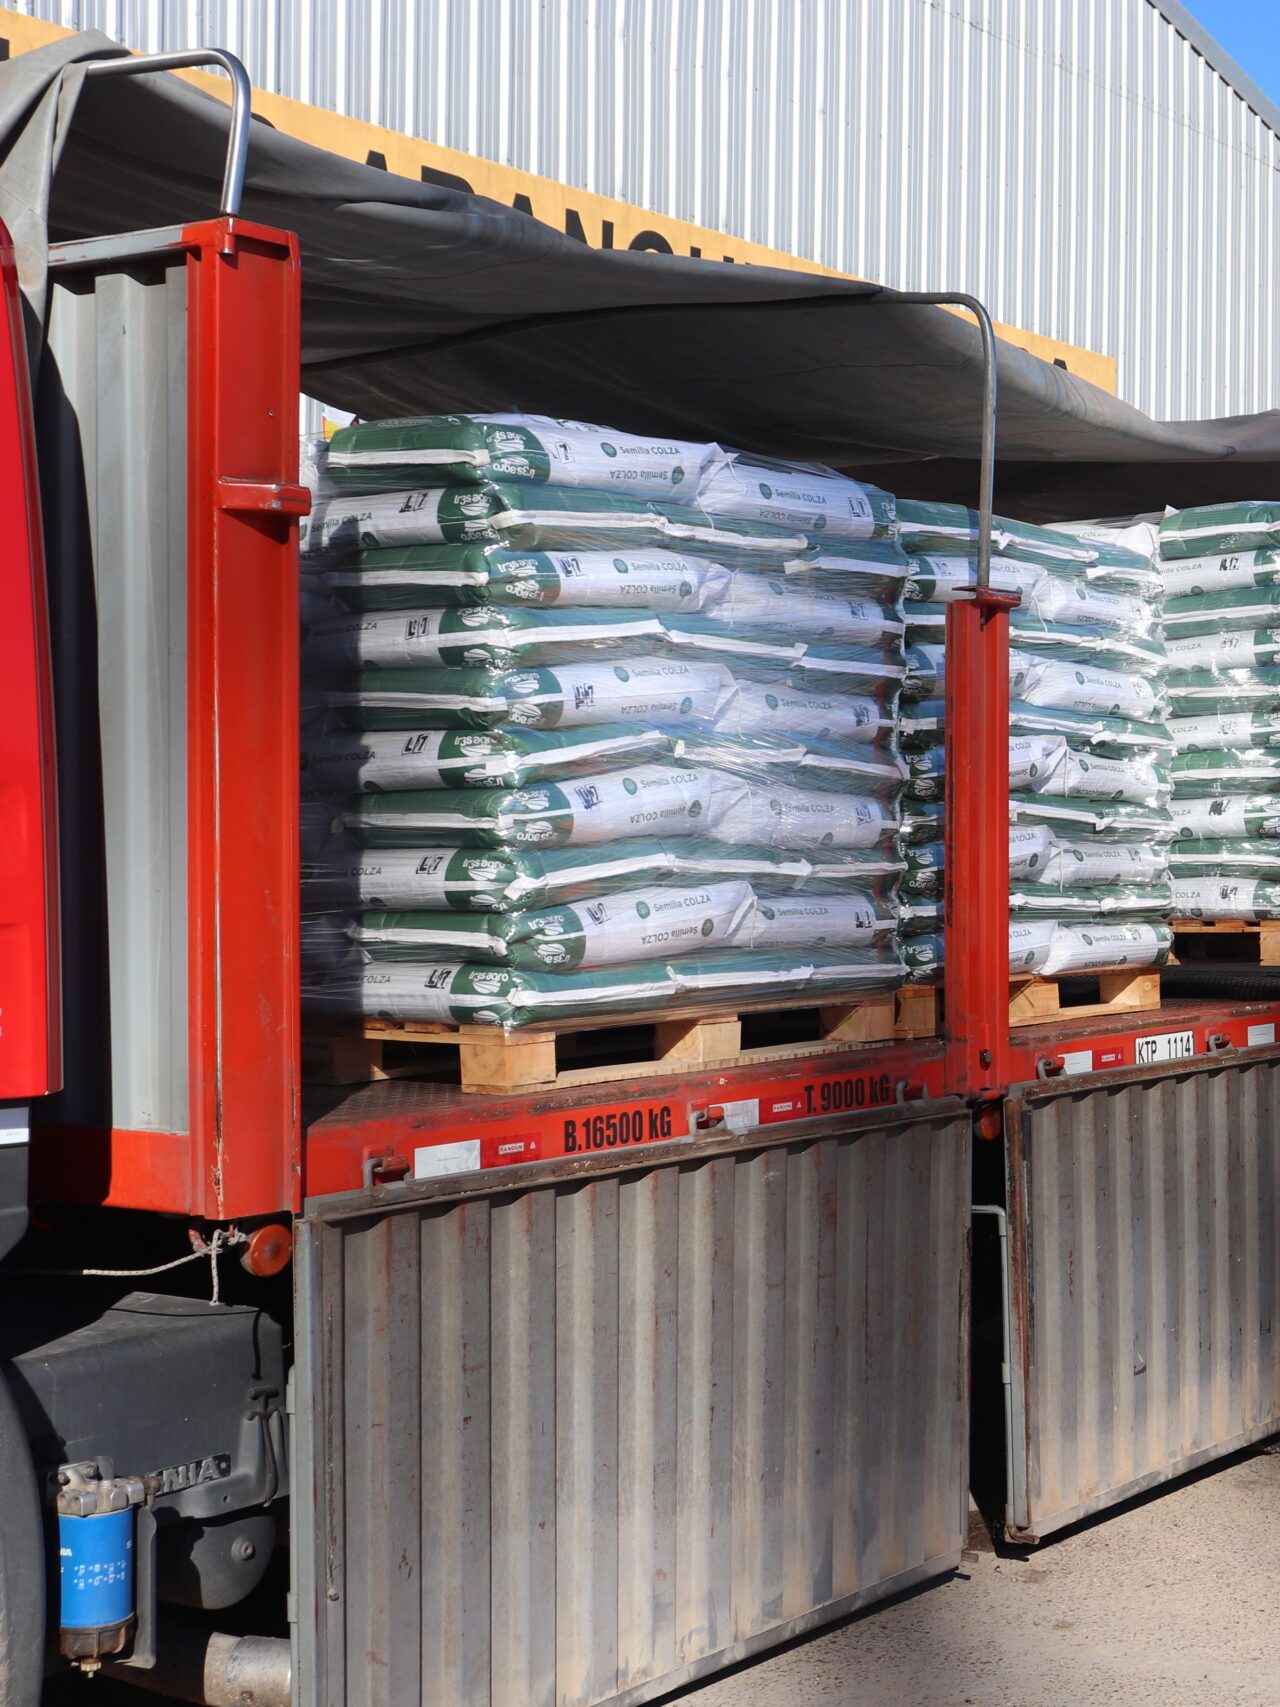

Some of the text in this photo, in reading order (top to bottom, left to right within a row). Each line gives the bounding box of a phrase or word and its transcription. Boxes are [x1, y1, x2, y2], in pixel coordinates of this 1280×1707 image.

[620, 446, 681, 455] Semilla COLZA
[342, 512, 372, 525] COLZA
[1176, 563, 1202, 571] COLZA
[662, 666, 689, 675] COLZA
[1172, 725, 1198, 733] COLZA
[671, 774, 698, 784] COLZA
[351, 867, 382, 876] COLZA
[1175, 891, 1200, 899] COLZA
[654, 895, 711, 912] Semilla COLZA
[641, 926, 698, 944] COLZA Semilla
[1137, 1034, 1191, 1064] KTP 1114
[820, 1077, 865, 1112] 9000
[163, 1457, 220, 1492] NIA
